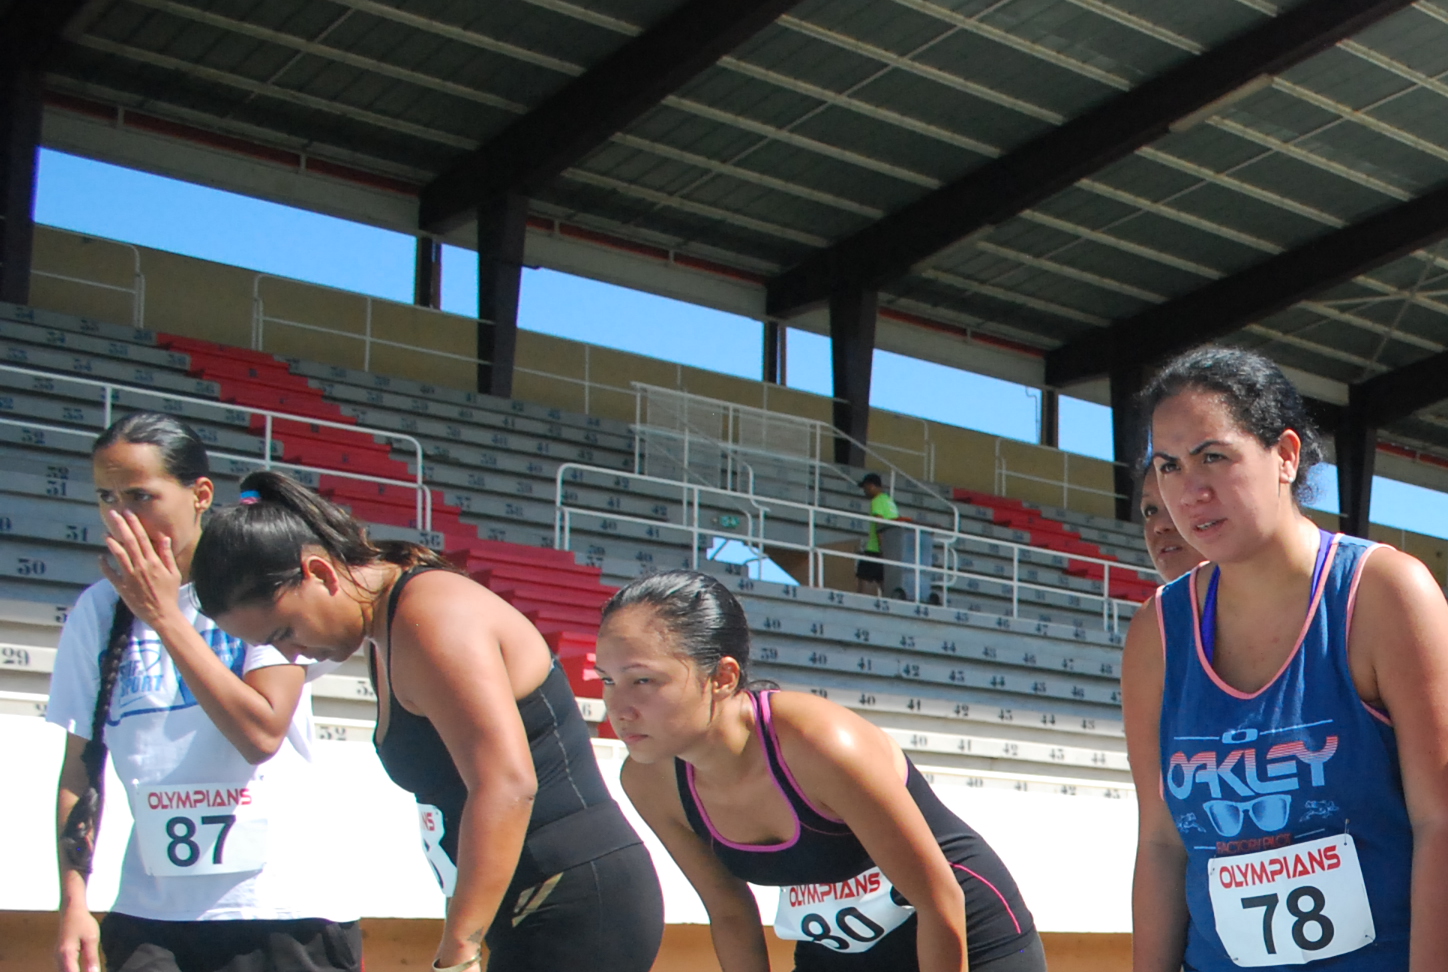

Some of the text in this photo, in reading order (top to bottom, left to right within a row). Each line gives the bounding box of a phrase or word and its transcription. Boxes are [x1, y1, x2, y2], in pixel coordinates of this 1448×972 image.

[763, 617, 781, 630] 40
[810, 623, 825, 636] 41
[854, 628, 870, 643] 42
[809, 651, 827, 665] 40
[857, 657, 873, 671] 41
[903, 663, 920, 677] 42
[859, 693, 876, 706] 40
[907, 699, 921, 711] 41
[954, 704, 969, 717] 42
[1167, 736, 1338, 800] OAKLEY
[147, 787, 253, 810] OLYMPIANS
[166, 813, 237, 868] 87
[1219, 845, 1341, 889] OLYMPIANS
[789, 872, 881, 908] OLYMPIANS
[800, 907, 885, 951] 80
[1240, 885, 1335, 954] 78
